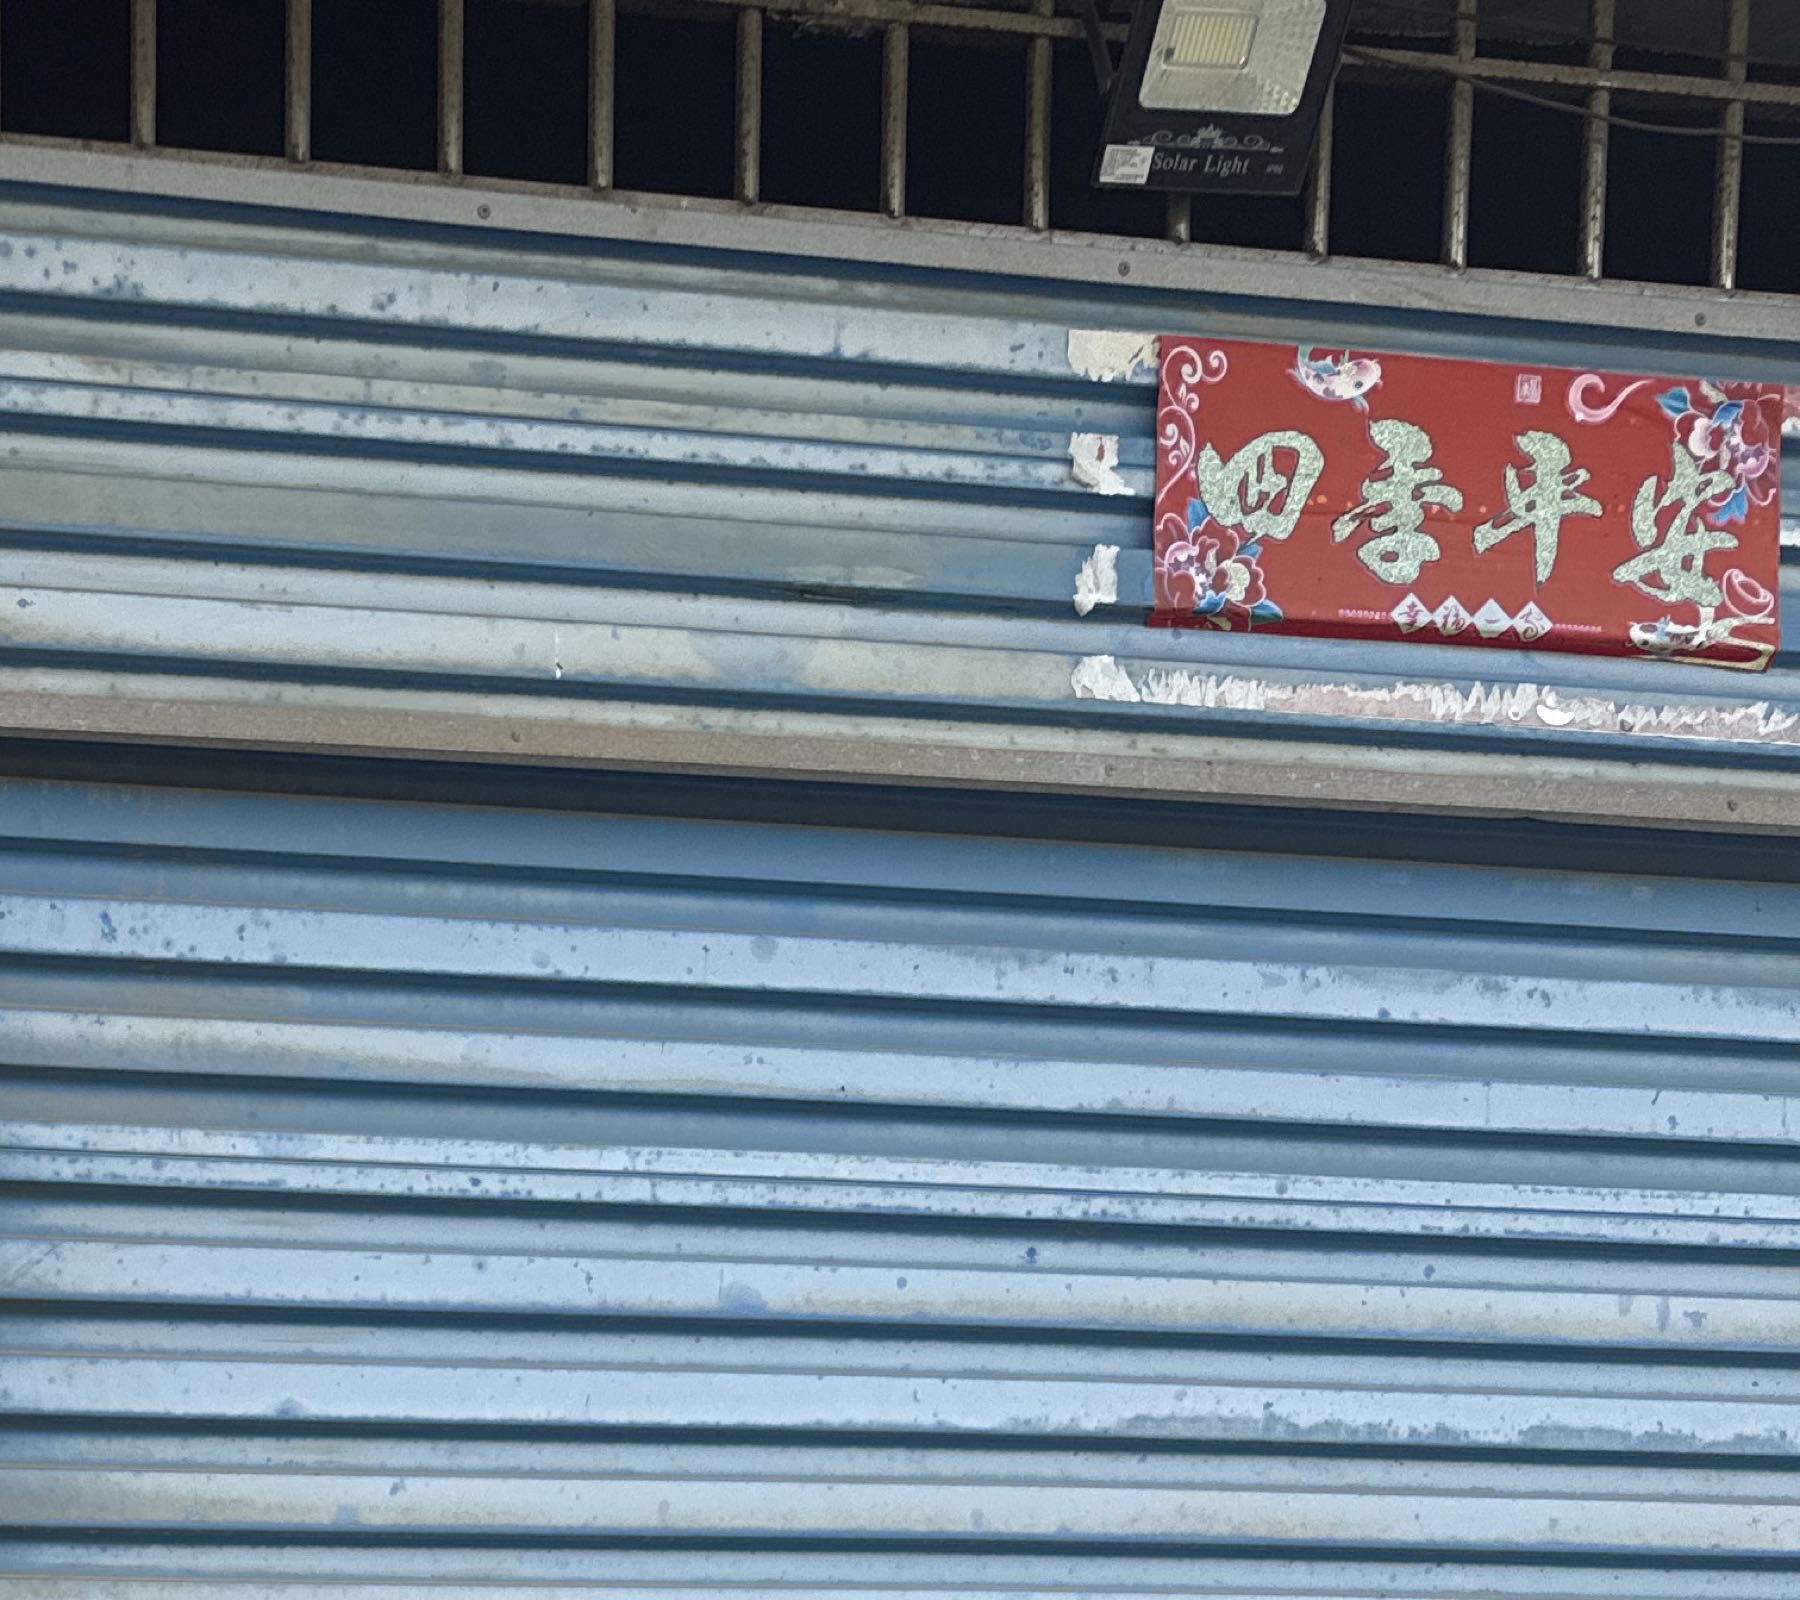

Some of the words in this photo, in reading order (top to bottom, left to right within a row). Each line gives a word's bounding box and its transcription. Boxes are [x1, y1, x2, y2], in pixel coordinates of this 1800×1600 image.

[1152, 152, 1198, 173] Solar
[1203, 154, 1250, 177] Light
[1197, 420, 1737, 607] 四季平安
